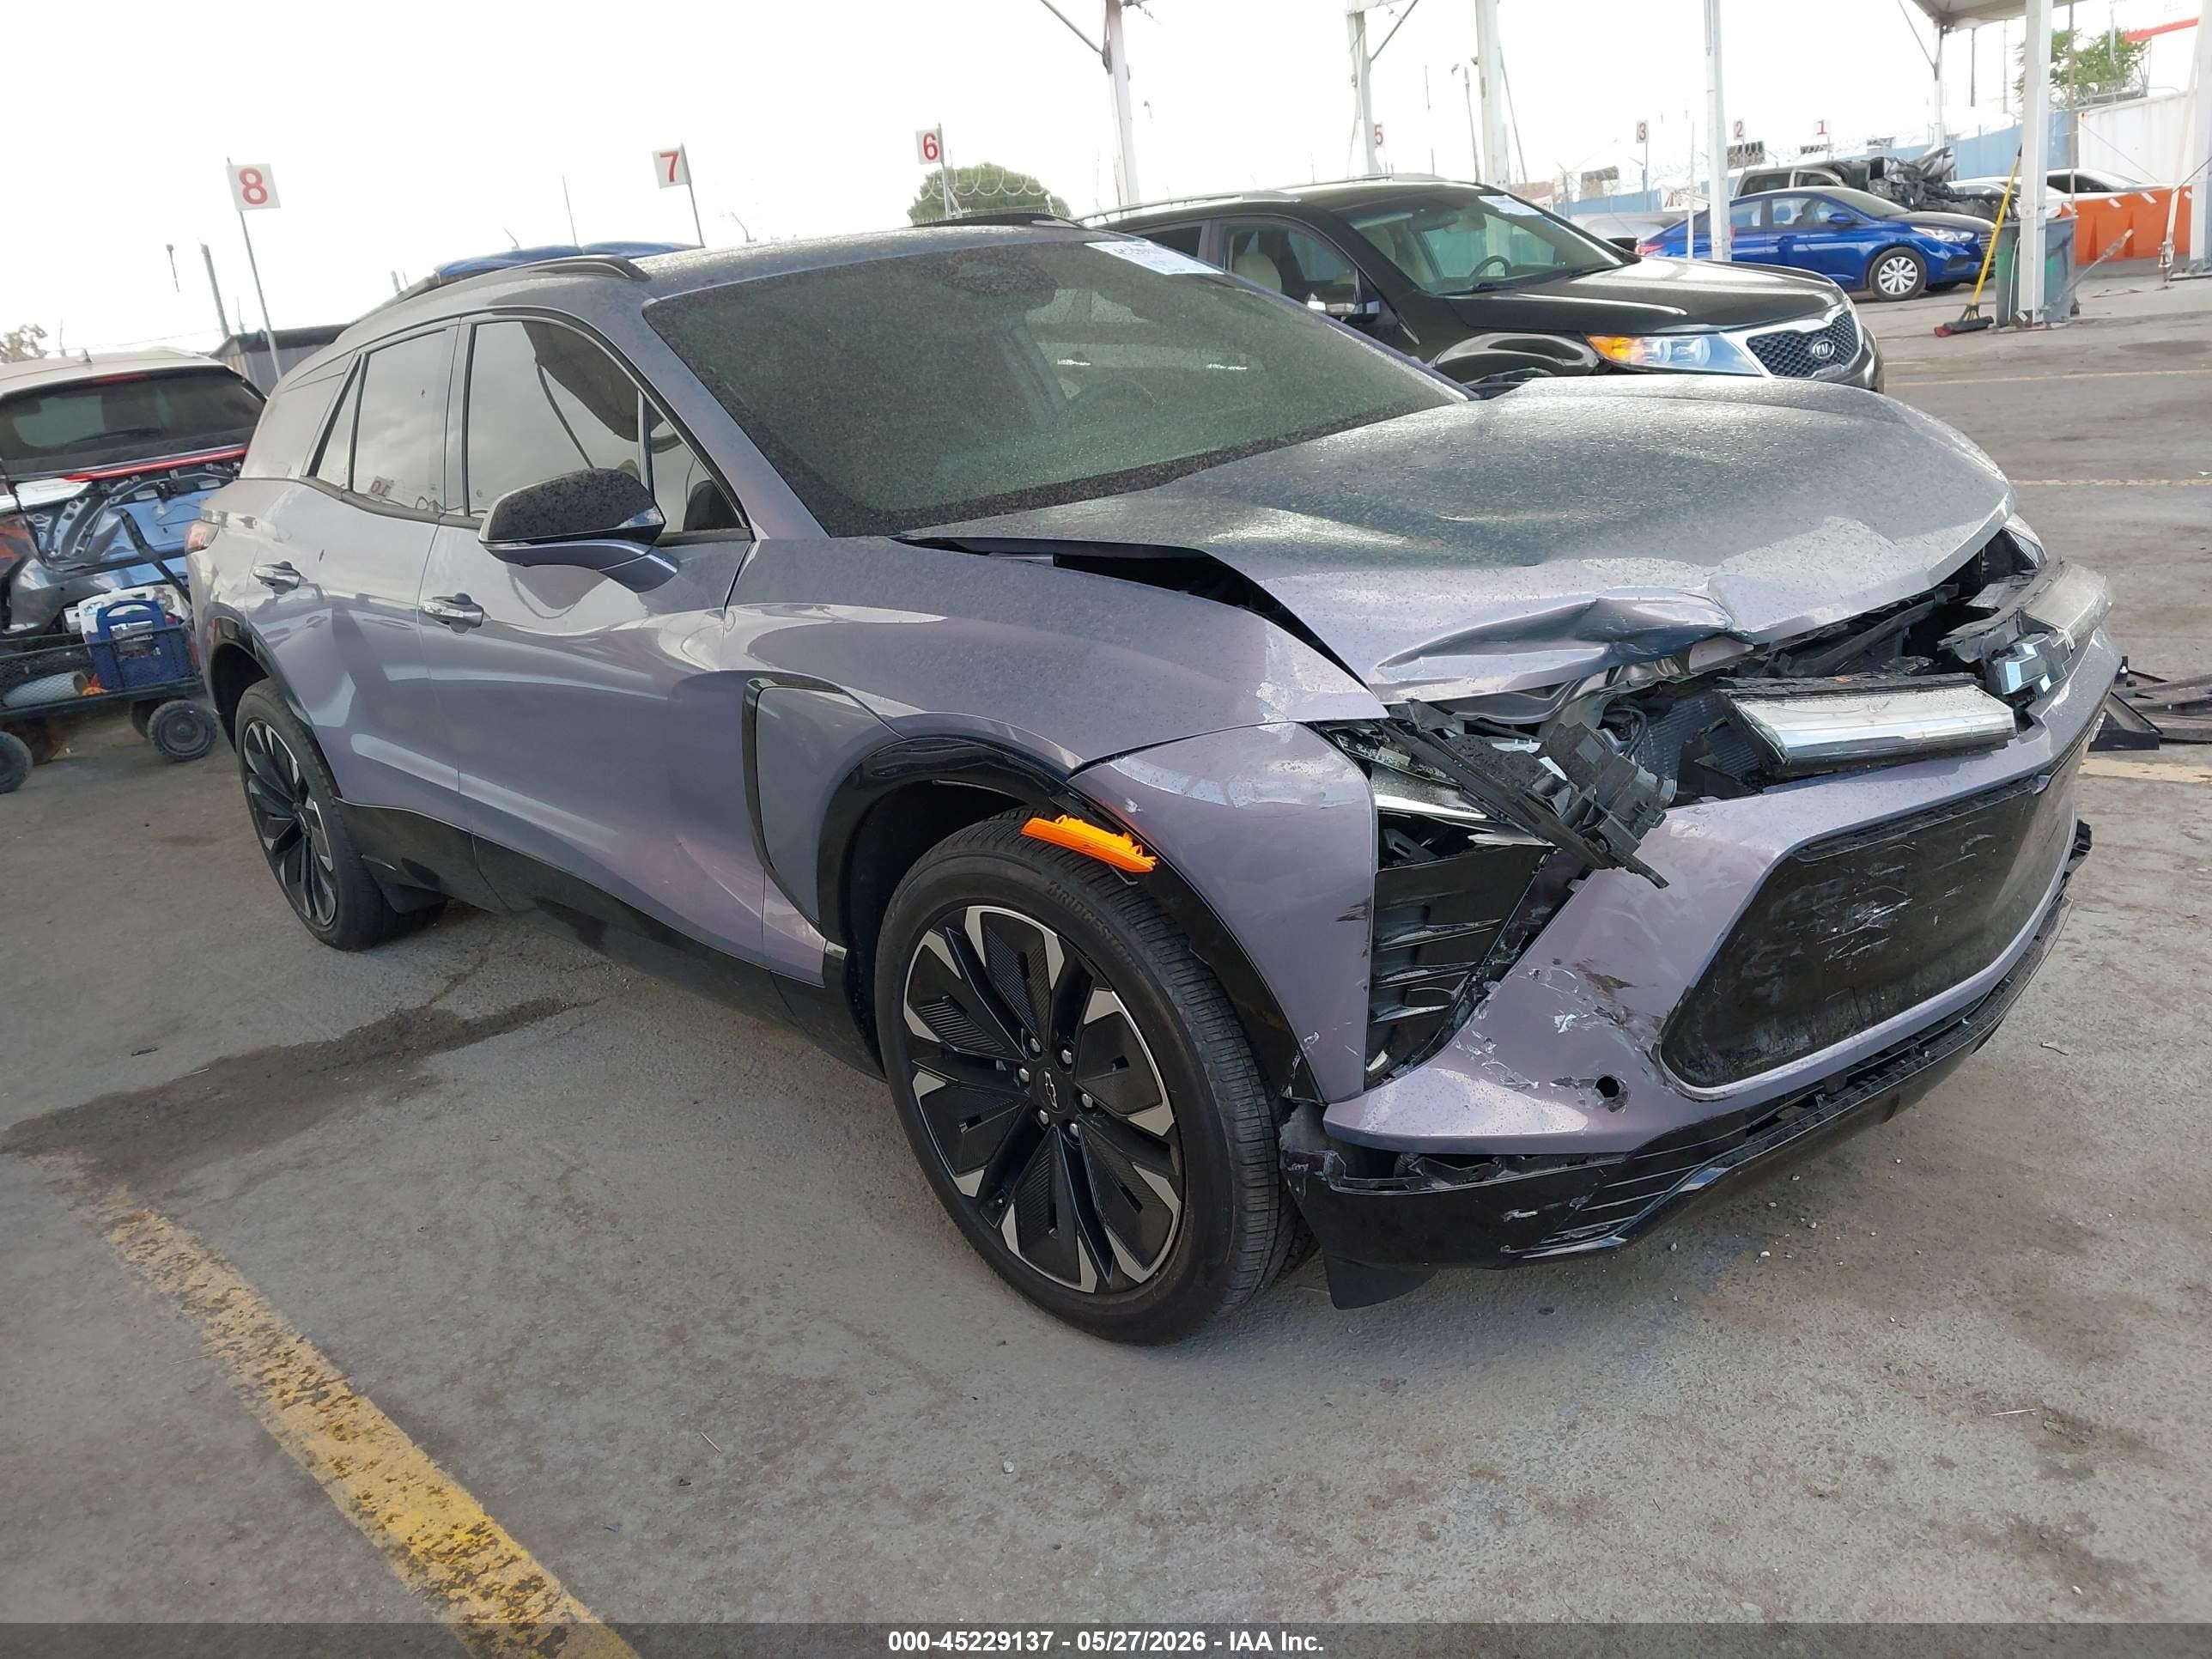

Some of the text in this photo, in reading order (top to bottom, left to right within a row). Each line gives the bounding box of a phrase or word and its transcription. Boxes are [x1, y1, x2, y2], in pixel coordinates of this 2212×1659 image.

[1374, 125, 1383, 145] 5
[1638, 122, 1647, 141] 3
[1735, 120, 1744, 138] 2
[1816, 119, 1827, 136] 1
[923, 132, 939, 161] 6
[659, 150, 679, 183] 7
[239, 167, 268, 205] 8
